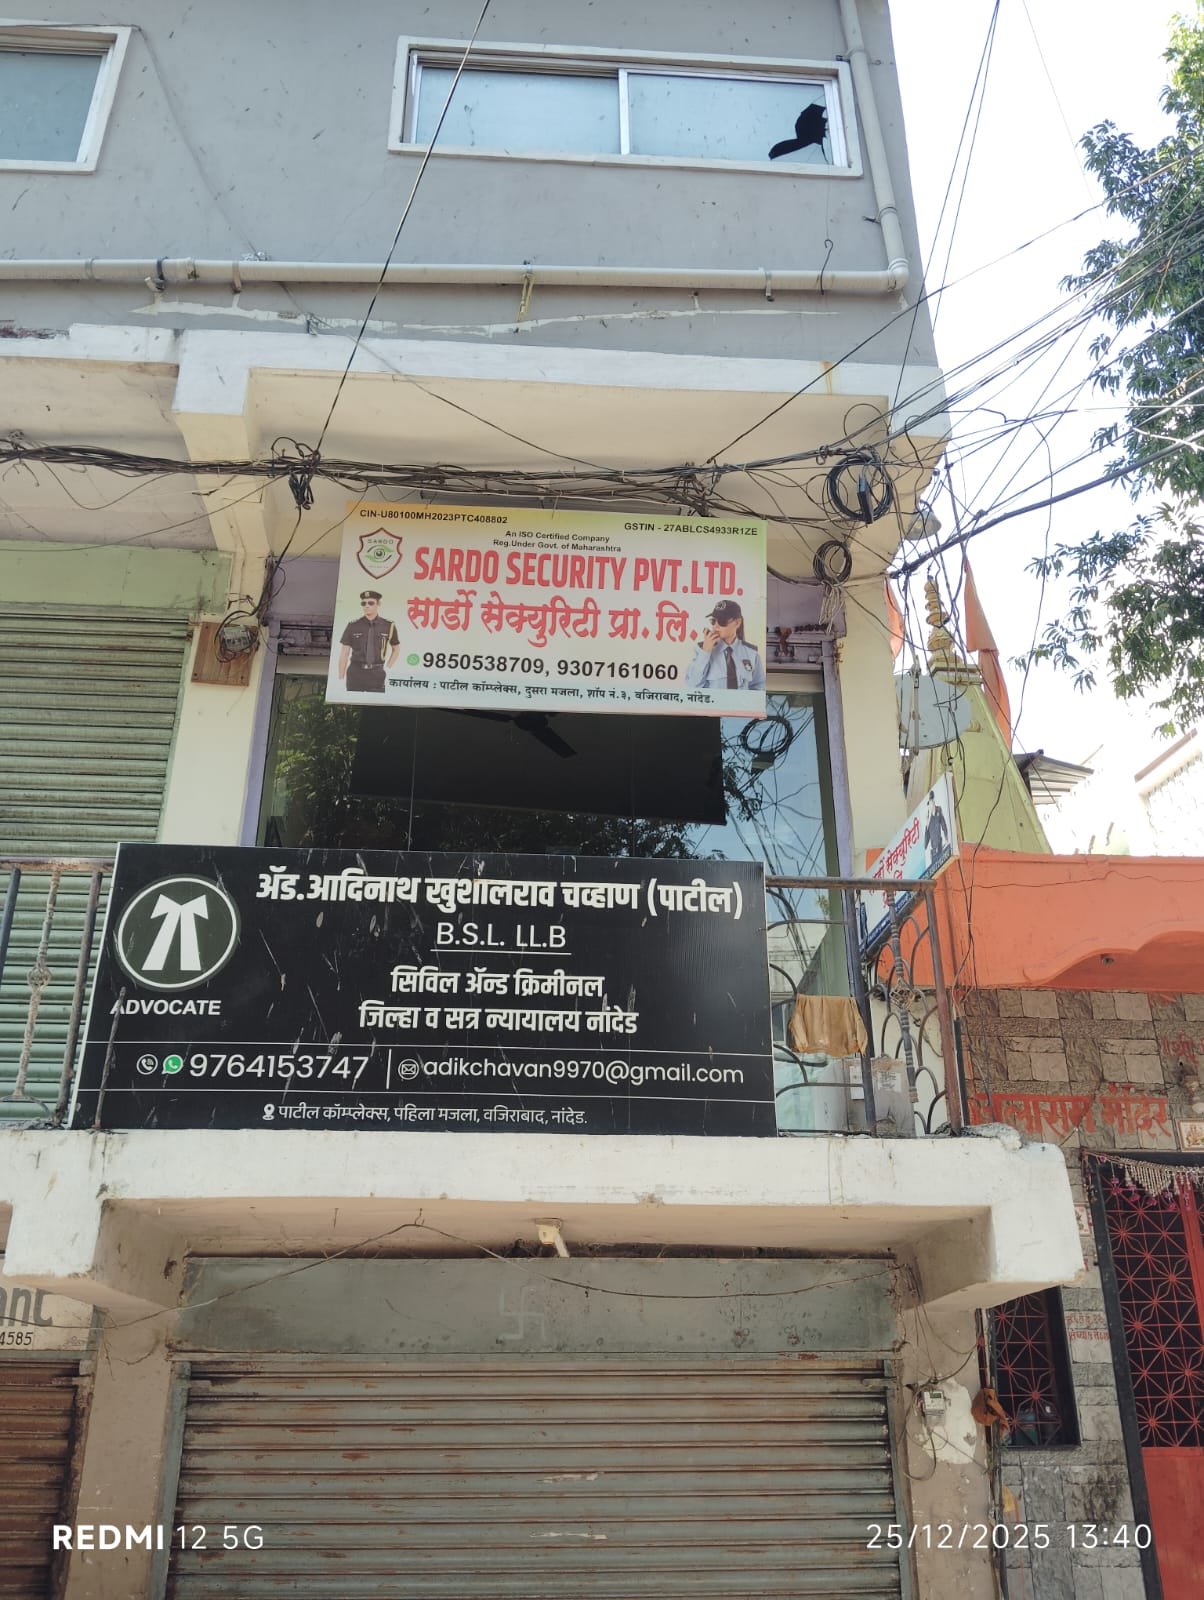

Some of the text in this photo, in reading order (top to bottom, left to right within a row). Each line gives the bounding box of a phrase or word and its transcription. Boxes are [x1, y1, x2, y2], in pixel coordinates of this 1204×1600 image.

[360, 509, 508, 524] CIN-U80100MH2023PTC408802
[624, 522, 655, 531] GSTIN
[664, 524, 758, 536] 27ABLCS4933R1ZE
[535, 532, 570, 540] Certified
[571, 534, 610, 543] Company
[537, 541, 558, 549] Govt.
[561, 542, 569, 550] of
[571, 543, 621, 552] Maharashtra
[414, 546, 744, 596] SARDO SECURITY PVT.LTD.
[480, 590, 601, 648] सेक्युरिटी
[608, 608, 650, 640] प्रा.
[655, 600, 699, 642] लि.
[423, 652, 679, 681] 9850538709, 9307161060
[388, 676, 430, 689] कार्यालय
[440, 679, 469, 692] पाटील
[525, 686, 548, 699] दुसरा
[550, 687, 584, 699] मजला,
[587, 687, 606, 699] शॉप
[425, 876, 557, 914] खुशालराव
[560, 881, 641, 910] चव्हाण
[647, 876, 744, 920] (पाटील)
[436, 922, 567, 949] B.S.L. LL.B
[391, 965, 461, 995] सिविल
[514, 968, 605, 998] क्रिमीनल
[110, 999, 222, 1017] ADVOCATE
[358, 1000, 639, 1035] जिल्हा व सत्र न्यायालय नांदेड
[189, 1054, 744, 1087] 9764153747 adikchavan9970@gmail.com
[278, 1102, 321, 1120] पाटील
[394, 1104, 436, 1121] पहिला
[438, 1107, 481, 1123] मजला,
[483, 1104, 549, 1125] वजिराबाद,
[551, 1107, 588, 1125] नांदेड.
